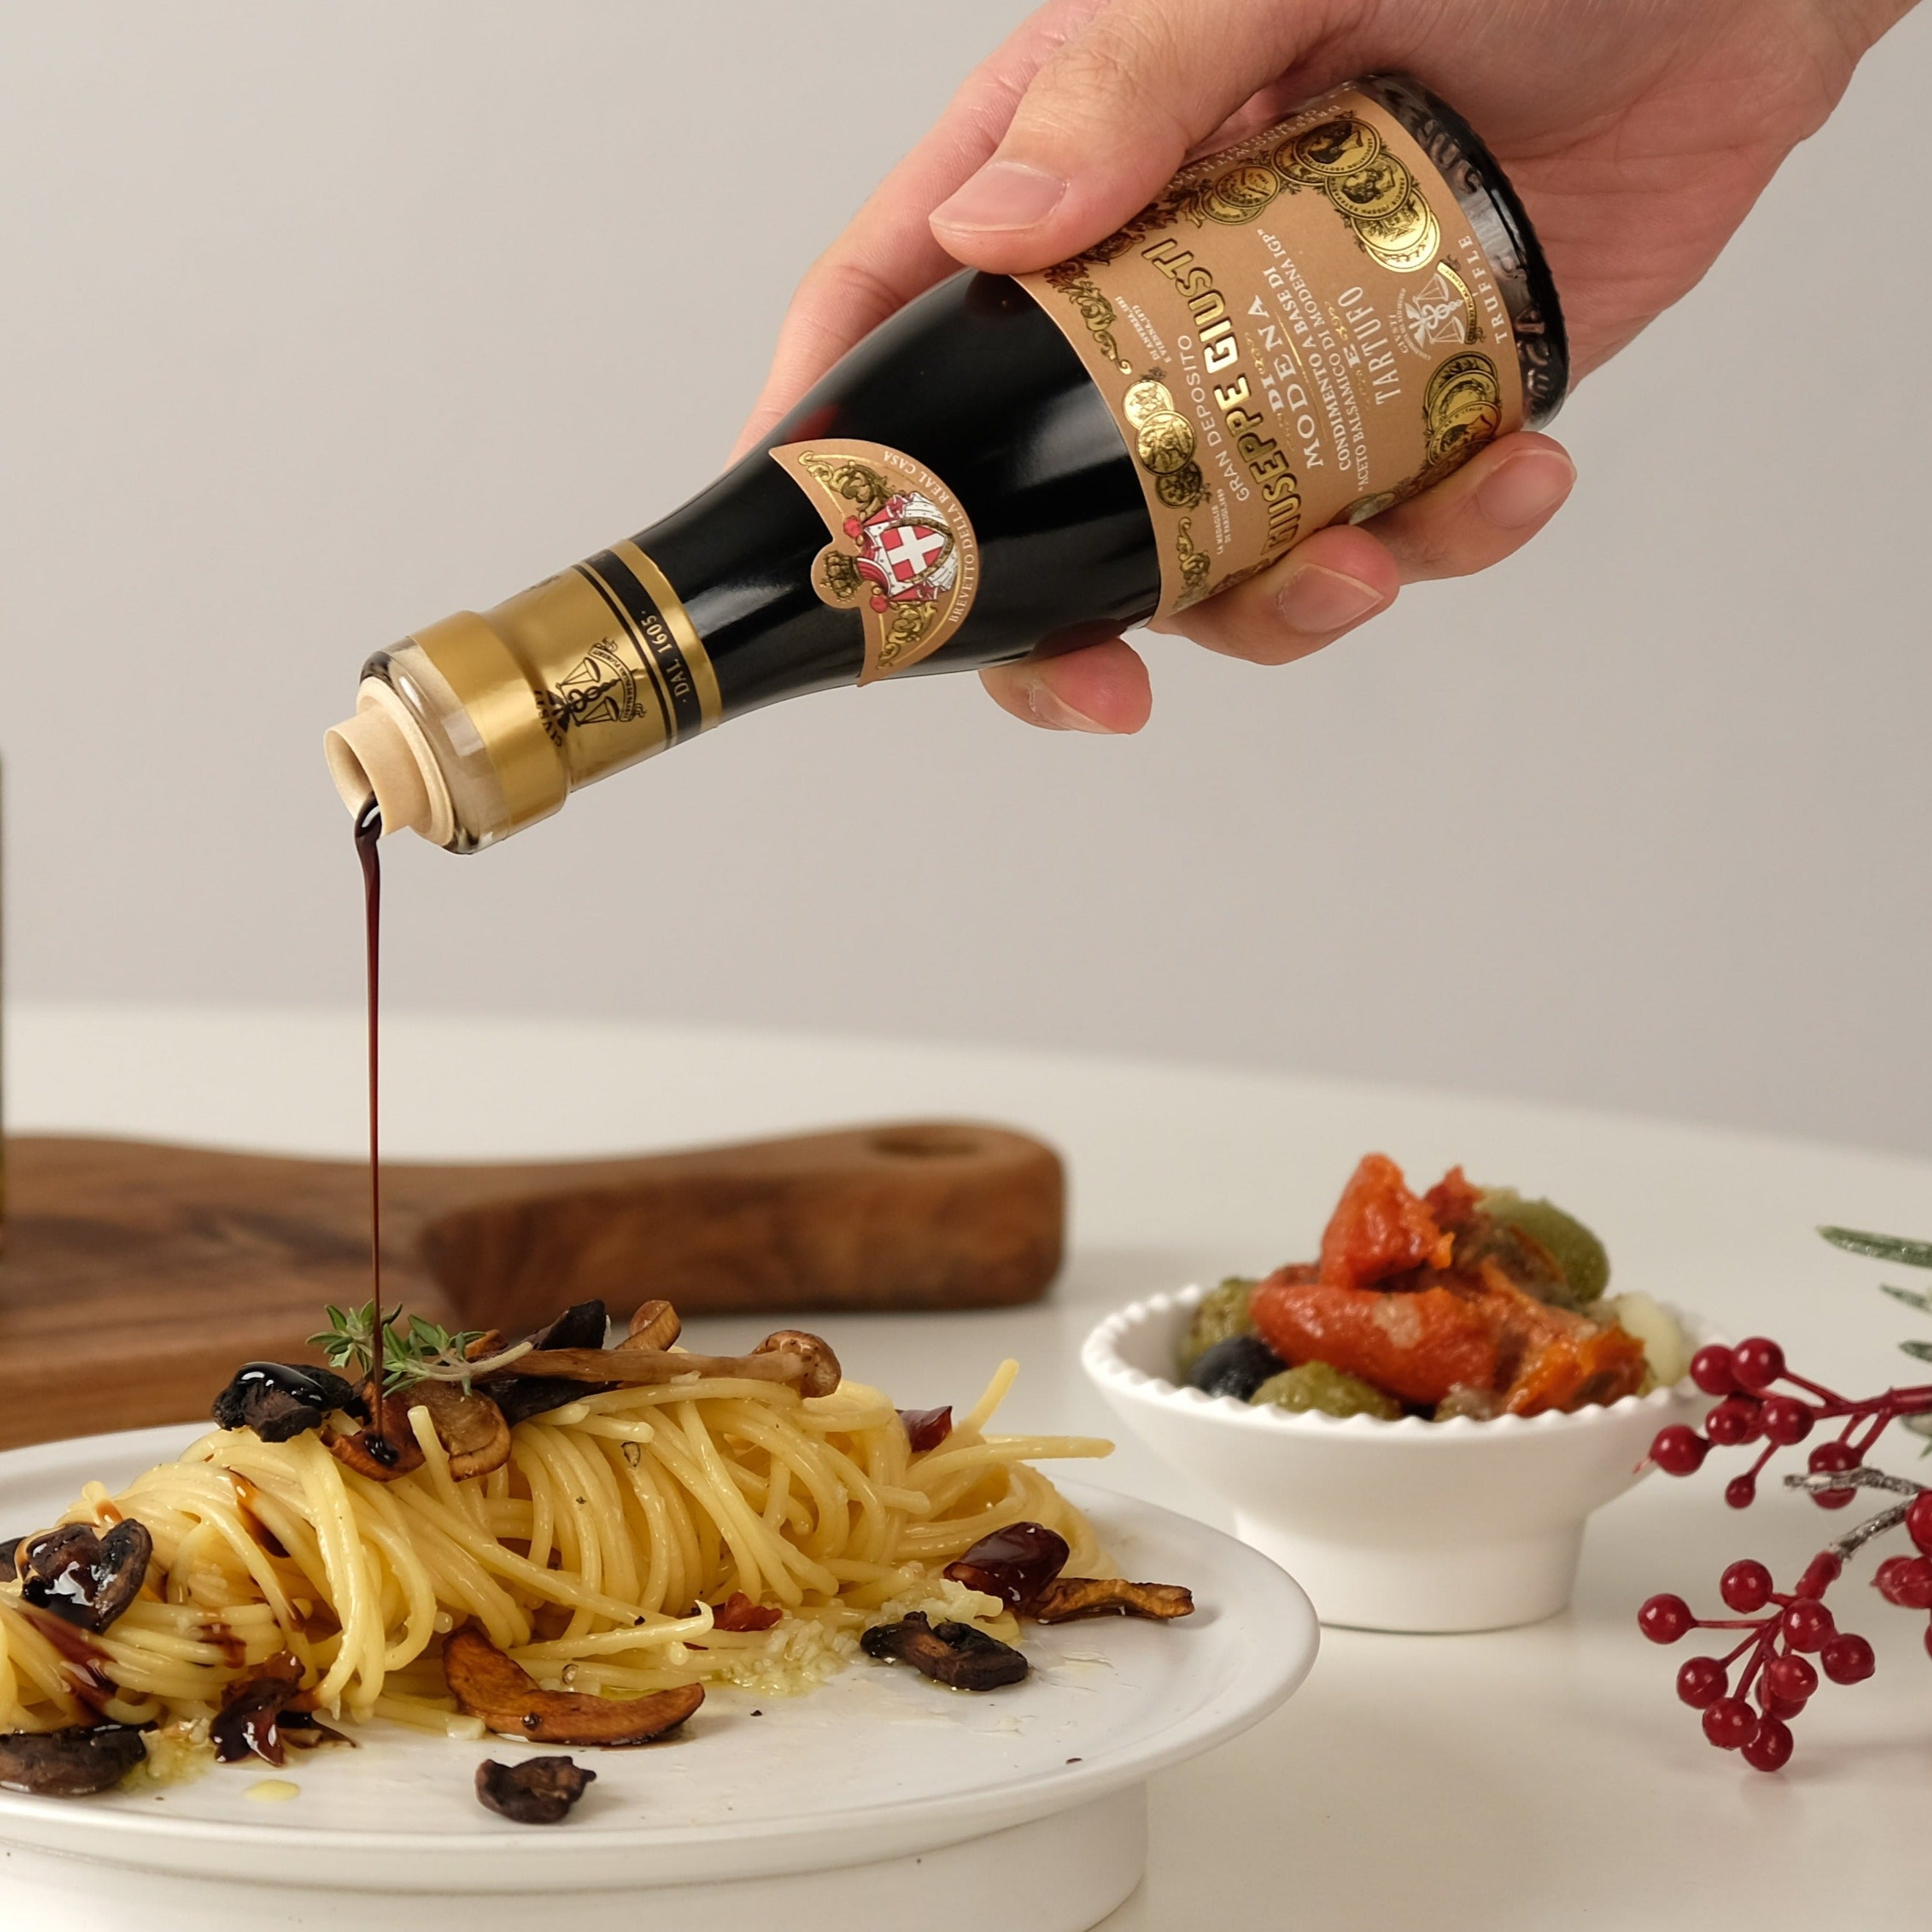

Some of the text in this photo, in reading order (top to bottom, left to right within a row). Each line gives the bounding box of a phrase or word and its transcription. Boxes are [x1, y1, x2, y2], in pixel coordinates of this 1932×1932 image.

[1140, 237, 1238, 374] GIUSTI
[1281, 258, 1326, 328] MODENA
[1318, 329, 1336, 351] DI
[1458, 235, 1508, 345] TRUFFLE
[1149, 349, 1161, 361] DI
[1247, 295, 1324, 469] MODENA
[1261, 374, 1285, 413] DI
[1263, 266, 1351, 472] CONDIMENTO A BASE DI
[1328, 353, 1365, 445] BALSAMICO
[1338, 285, 1402, 406] TARTUFO
[1342, 343, 1361, 369] E
[1177, 335, 1249, 501] GRAN DEPOSITO
[1214, 373, 1301, 555] GIUSEPPE
[882, 450, 975, 623] BREVETTO DELLA REAL CASA
[640, 614, 691, 697] DAL 1605
